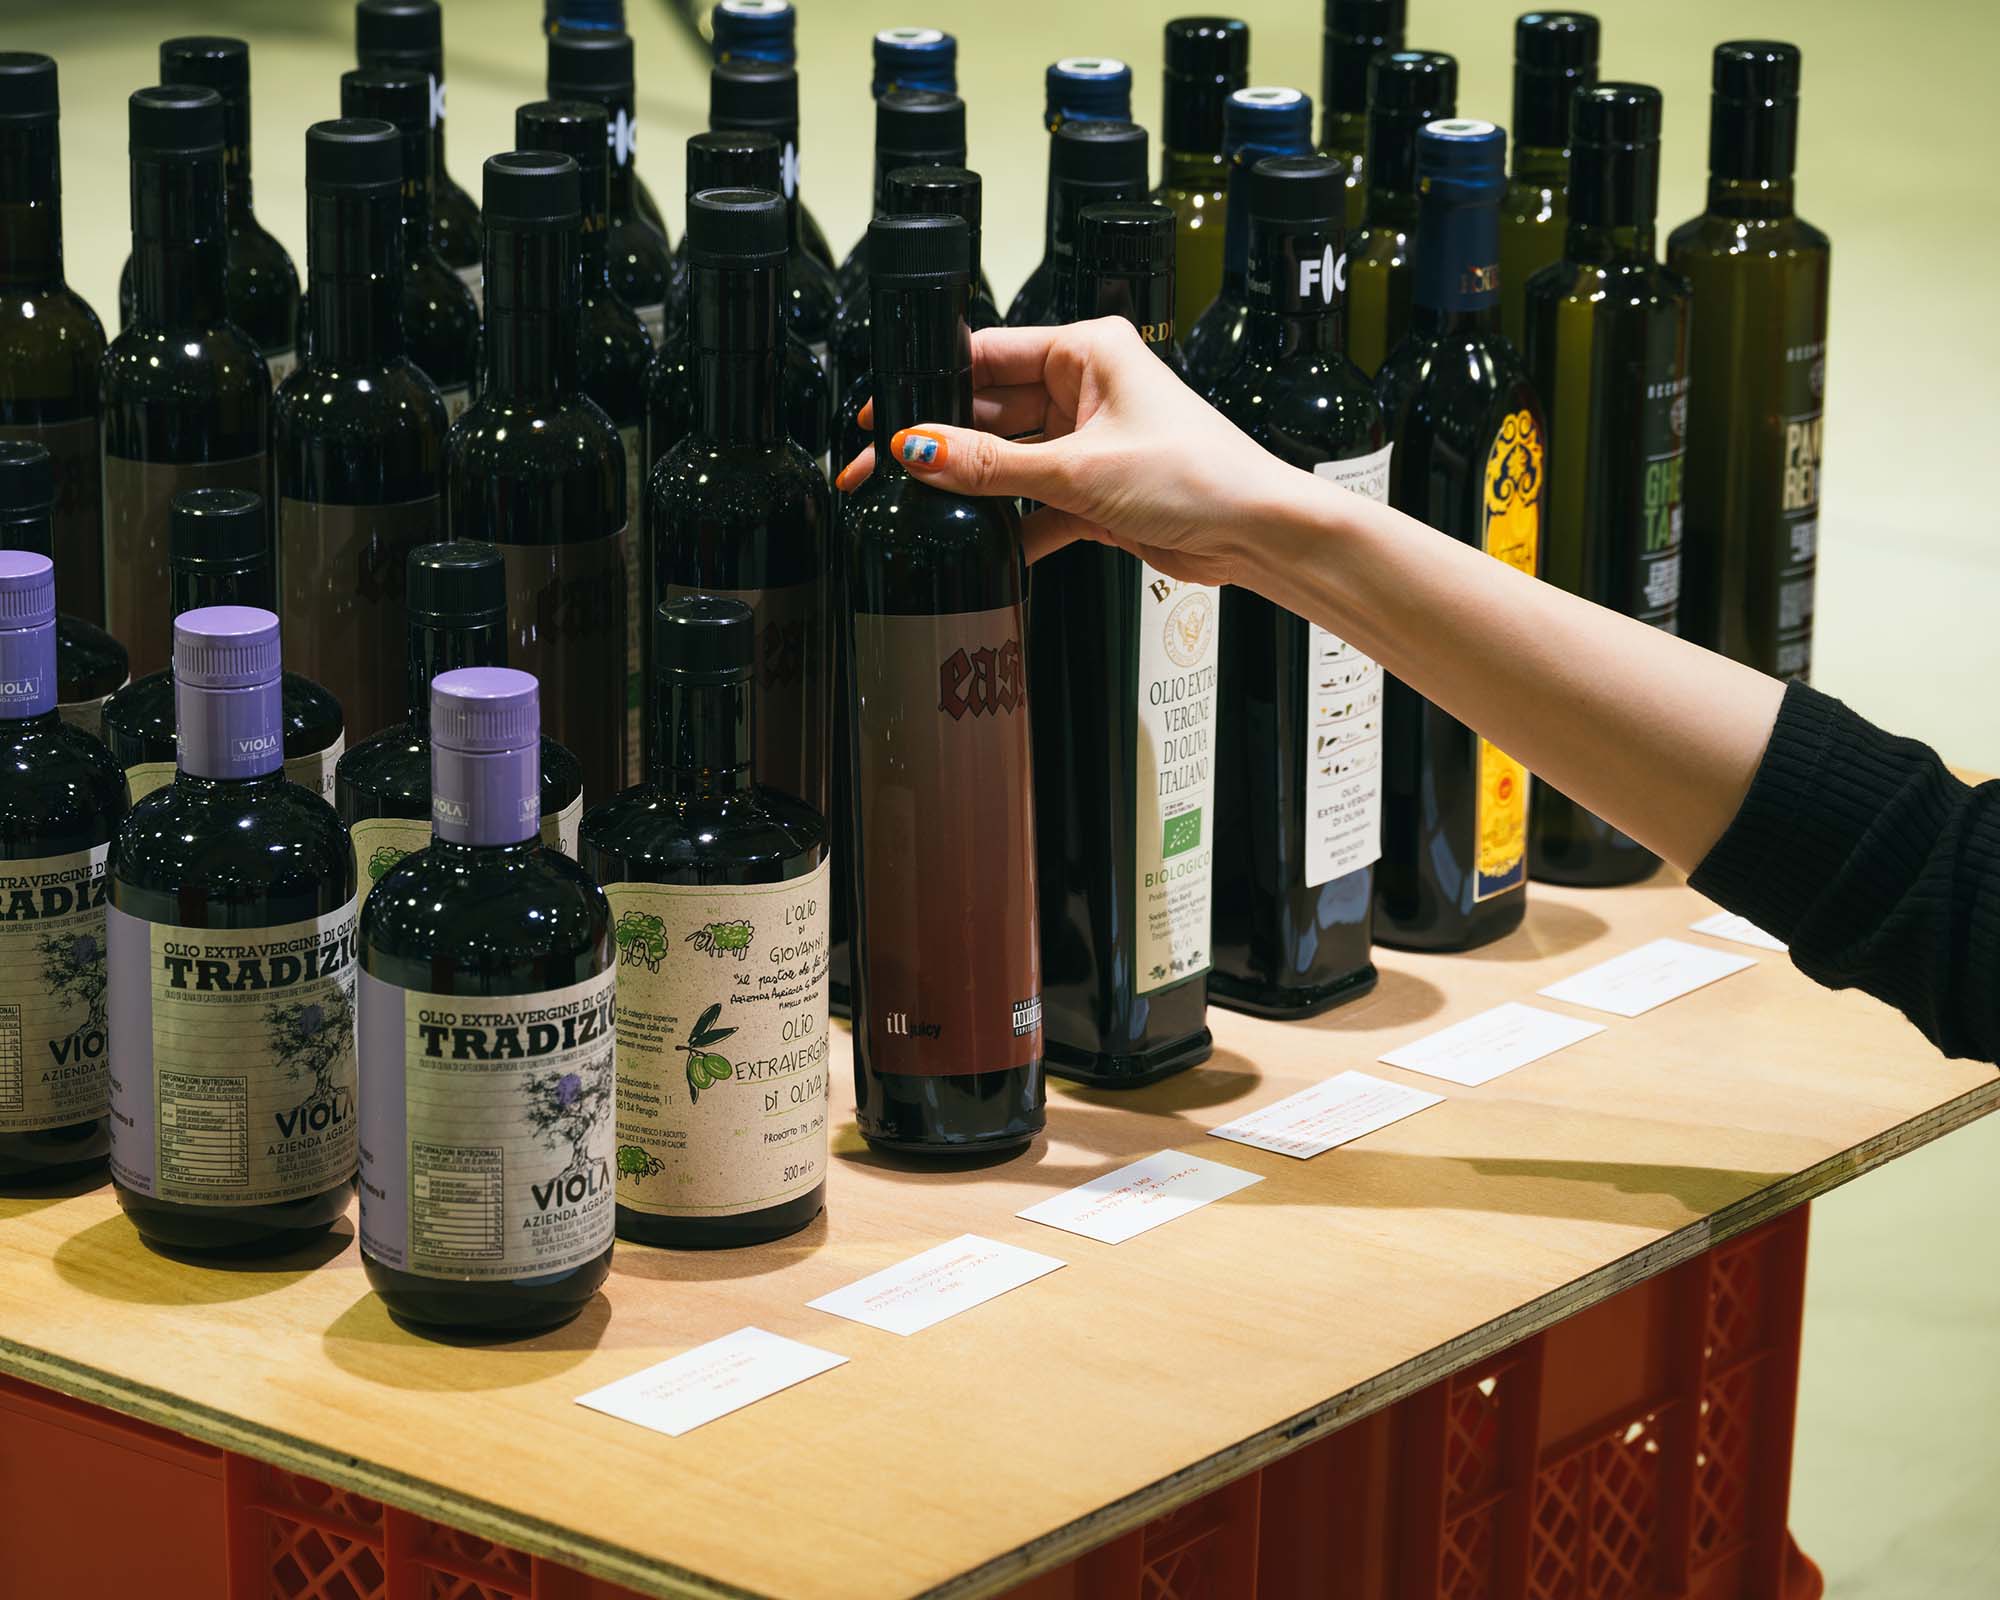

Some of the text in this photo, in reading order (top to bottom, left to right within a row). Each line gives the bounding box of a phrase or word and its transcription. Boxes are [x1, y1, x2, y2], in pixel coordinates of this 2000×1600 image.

[1150, 676, 1185, 706] OLIO
[1164, 696, 1210, 734] VERGINE
[239, 735, 277, 753] VIOLA
[1163, 728, 1208, 765] DI OLIVA
[1159, 757, 1209, 796] ITALIANO
[0, 866, 93, 889] TRAVERGINE
[1145, 850, 1210, 888] BIOLOGICO
[164, 942, 200, 958] OLIO
[204, 933, 321, 959] EXTRAVERGINE
[323, 928, 336, 943] DI
[758, 968, 797, 990] pastore
[419, 1010, 457, 1027] OLIO
[461, 1001, 580, 1027] EXTRAVERGINE
[582, 996, 594, 1011] DI
[41, 1063, 97, 1083] AZIENDA
[266, 1137, 322, 1156] AZIENDA
[763, 1128, 798, 1145] PRODOTTO
[800, 1122, 809, 1135] IN
[531, 1160, 610, 1211] VIOLA
[523, 1208, 578, 1229] AZIENDA
